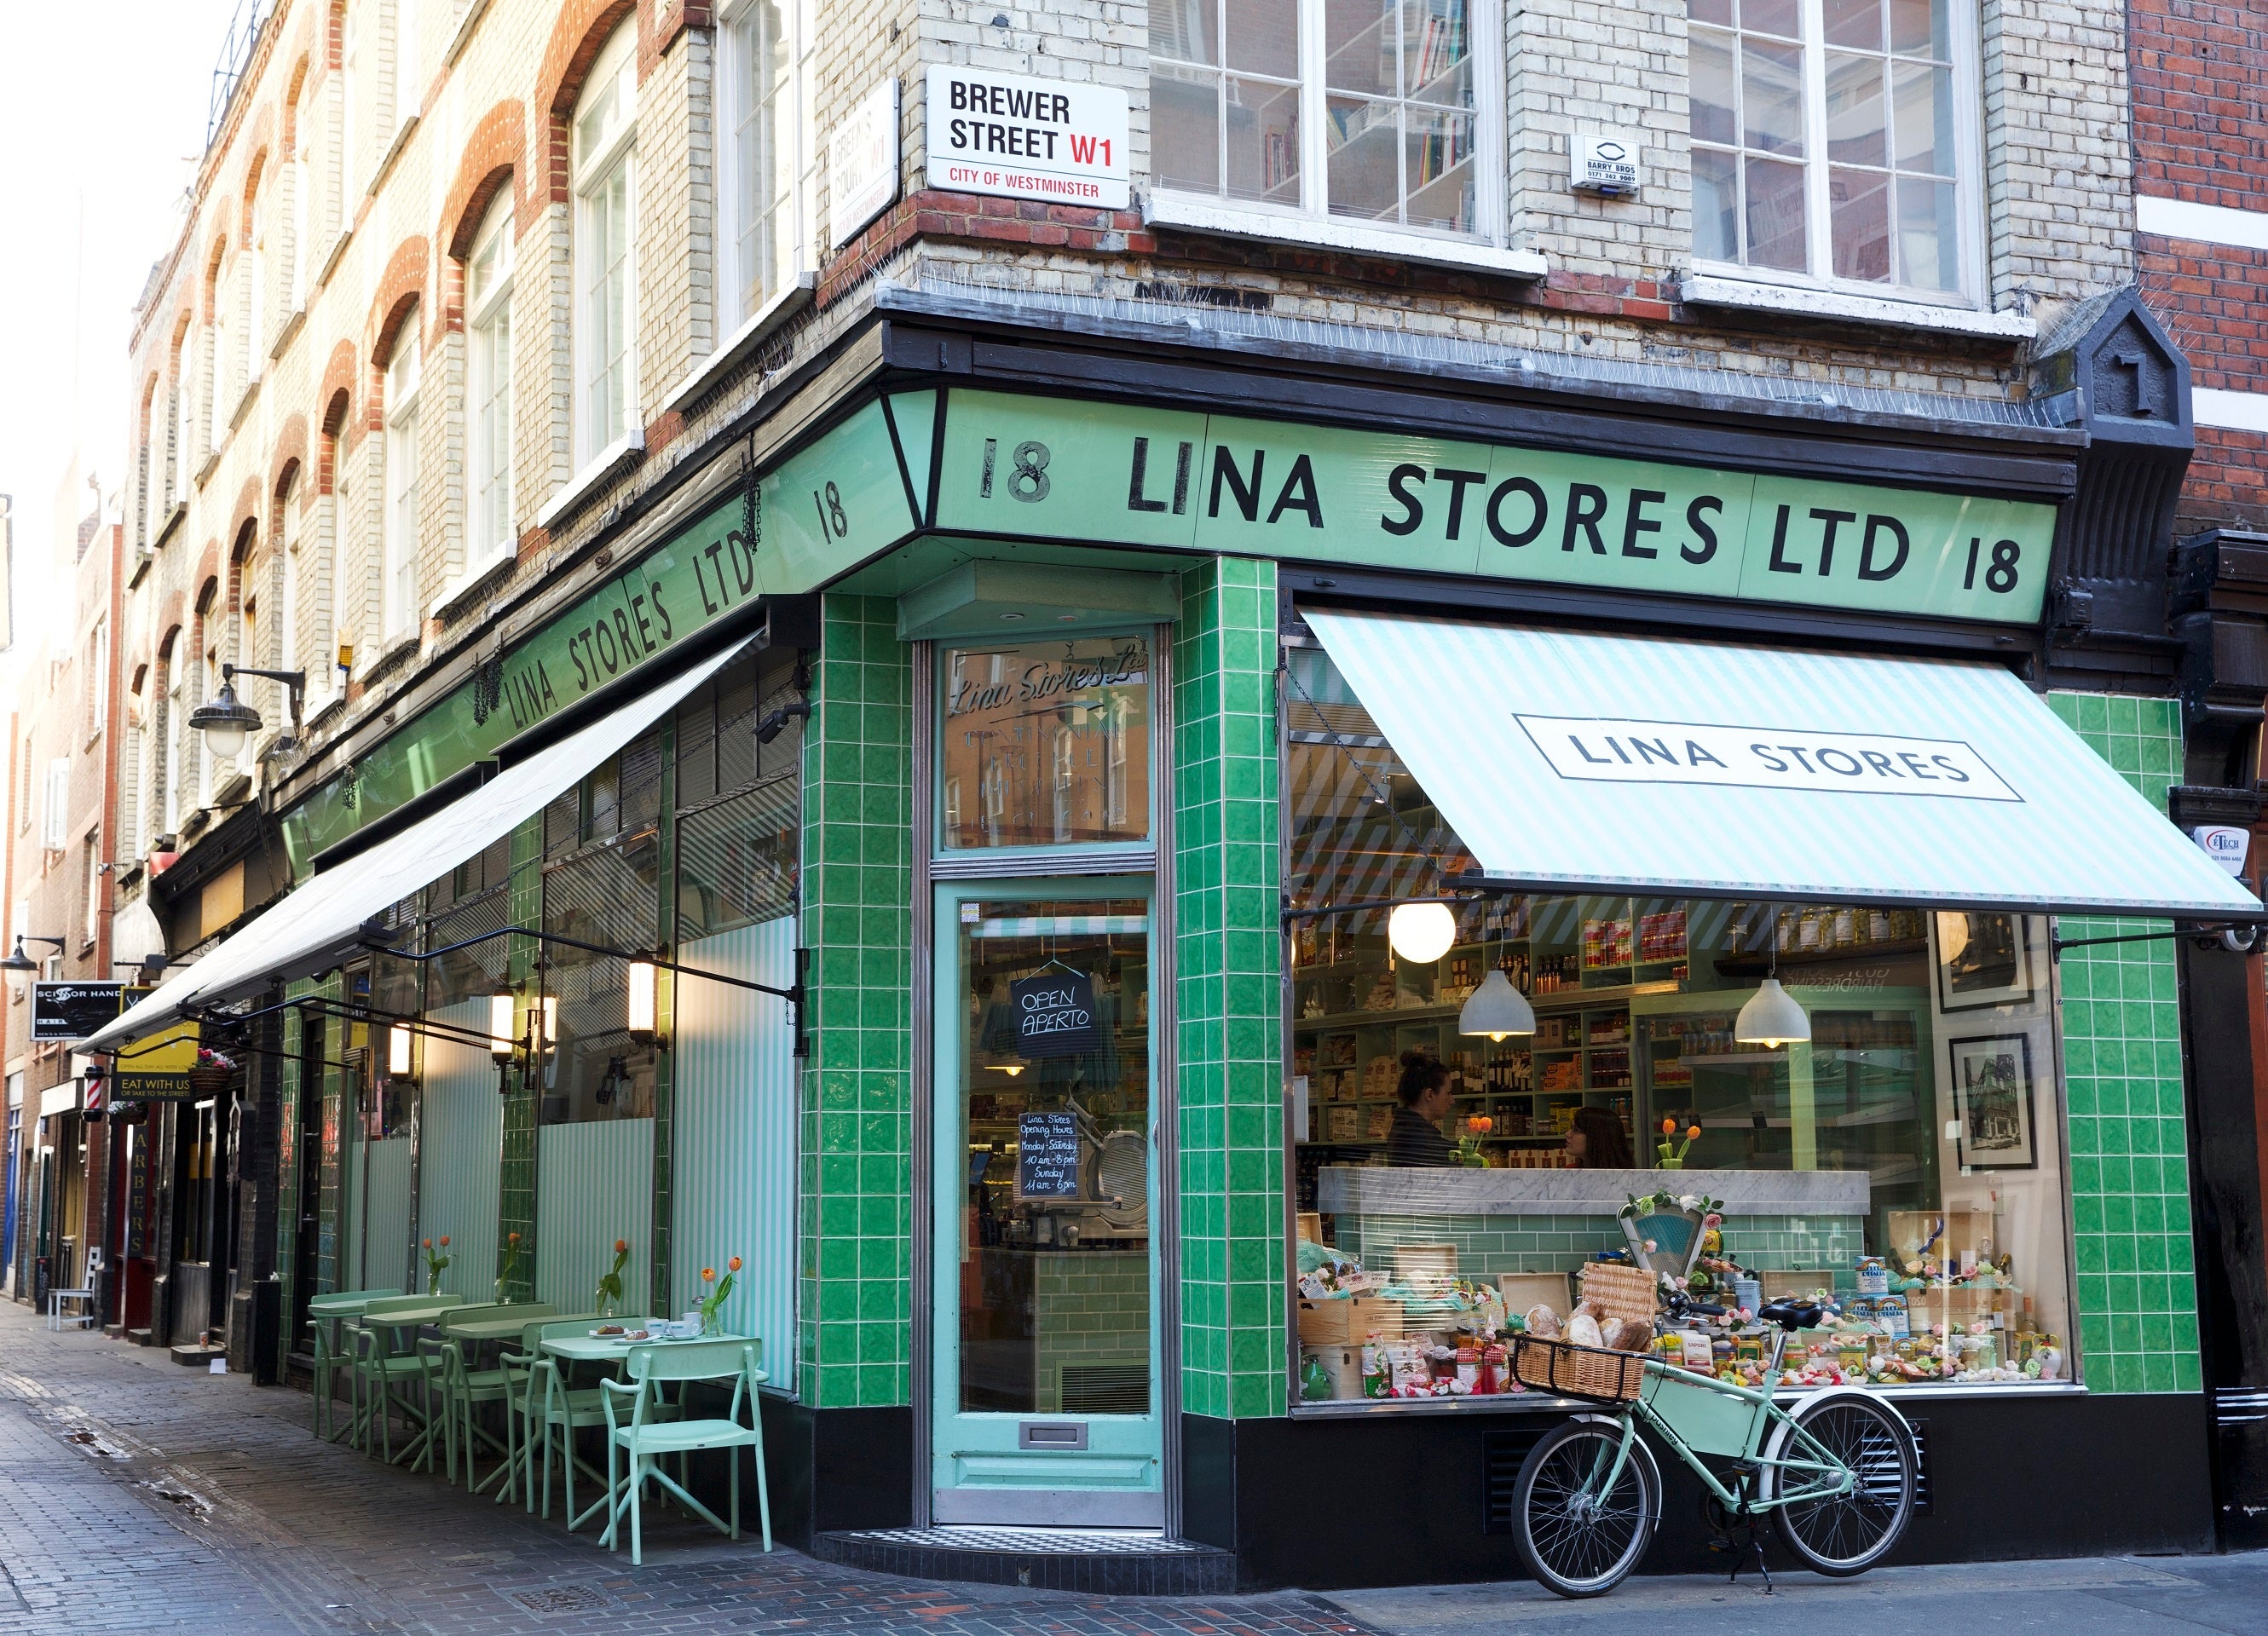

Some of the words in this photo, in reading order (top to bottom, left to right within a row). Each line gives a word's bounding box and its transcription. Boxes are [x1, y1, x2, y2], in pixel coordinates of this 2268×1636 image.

[950, 81, 1070, 124] BREWER
[950, 119, 1059, 159] STREET
[1071, 134, 1111, 166] W1
[1588, 161, 1612, 170] BARRY
[950, 168, 978, 183] CITY
[984, 172, 1000, 185] OF
[1006, 174, 1099, 198] WESTMINSTER
[980, 438, 1050, 503] 18
[1128, 437, 1324, 529] LINA
[1381, 464, 1723, 566] STORES
[1769, 504, 1910, 581] LTD
[1963, 538, 2021, 594] 18
[504, 660, 558, 730] LINA
[568, 581, 672, 692] STORES
[692, 529, 754, 617] LTD
[813, 480, 848, 545] 18
[948, 680, 1013, 717] Lina
[1020, 655, 1104, 702] Stores
[1567, 734, 1728, 769] LINA
[1750, 743, 1971, 783] STORES
[37, 987, 86, 1001] SCISSOR
[1022, 986, 1075, 1010] OPEN
[1022, 1009, 1089, 1034] APERTO
[122, 1079, 141, 1089] EAT
[145, 1080, 172, 1089] WITH
[176, 1080, 190, 1090] US
[1020, 1125, 1050, 1138] Opening
[1053, 1125, 1073, 1135] Hours
[1027, 1115, 1044, 1124] Lina
[131, 1119, 147, 1253] ARBERS
[1034, 1166, 1065, 1181] Sunday
